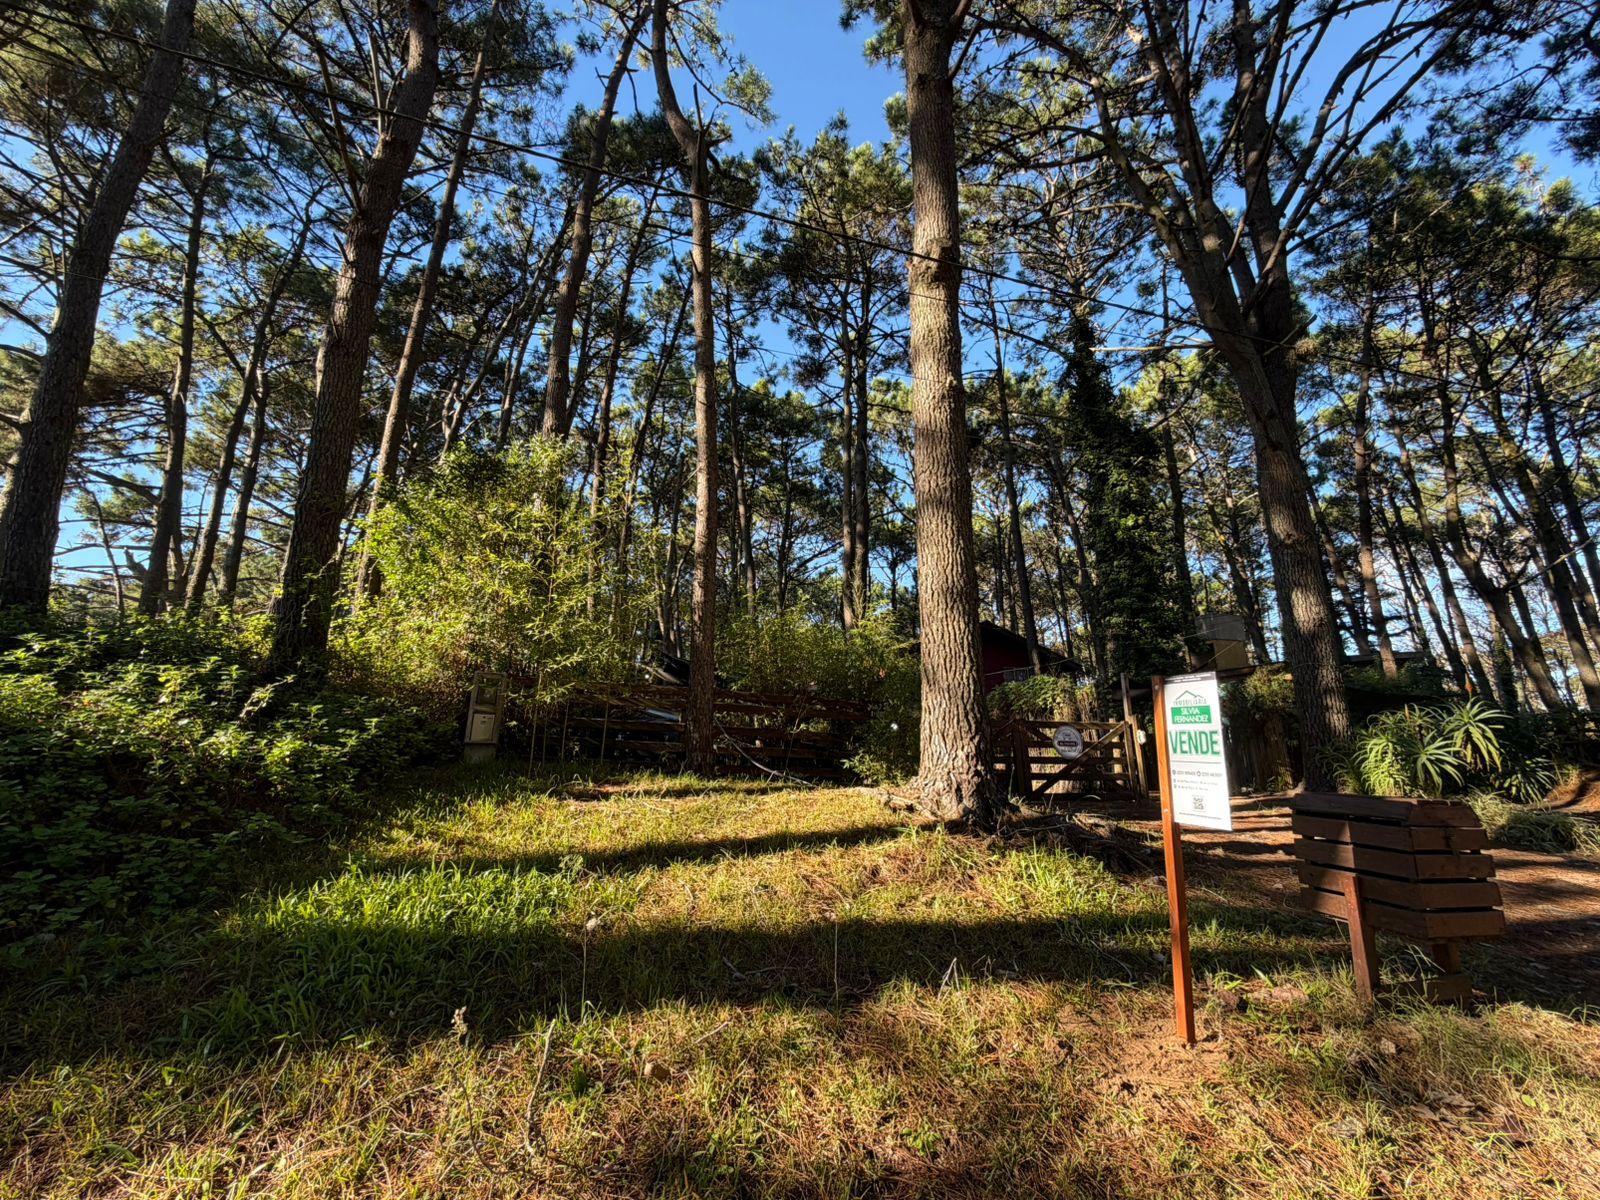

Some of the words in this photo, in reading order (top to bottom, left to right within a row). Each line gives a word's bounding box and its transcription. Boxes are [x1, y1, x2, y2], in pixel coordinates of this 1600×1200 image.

[1182, 707, 1200, 715] SILVIA
[1174, 715, 1209, 723] FERNANDEZ
[1169, 731, 1220, 755] VENDE
